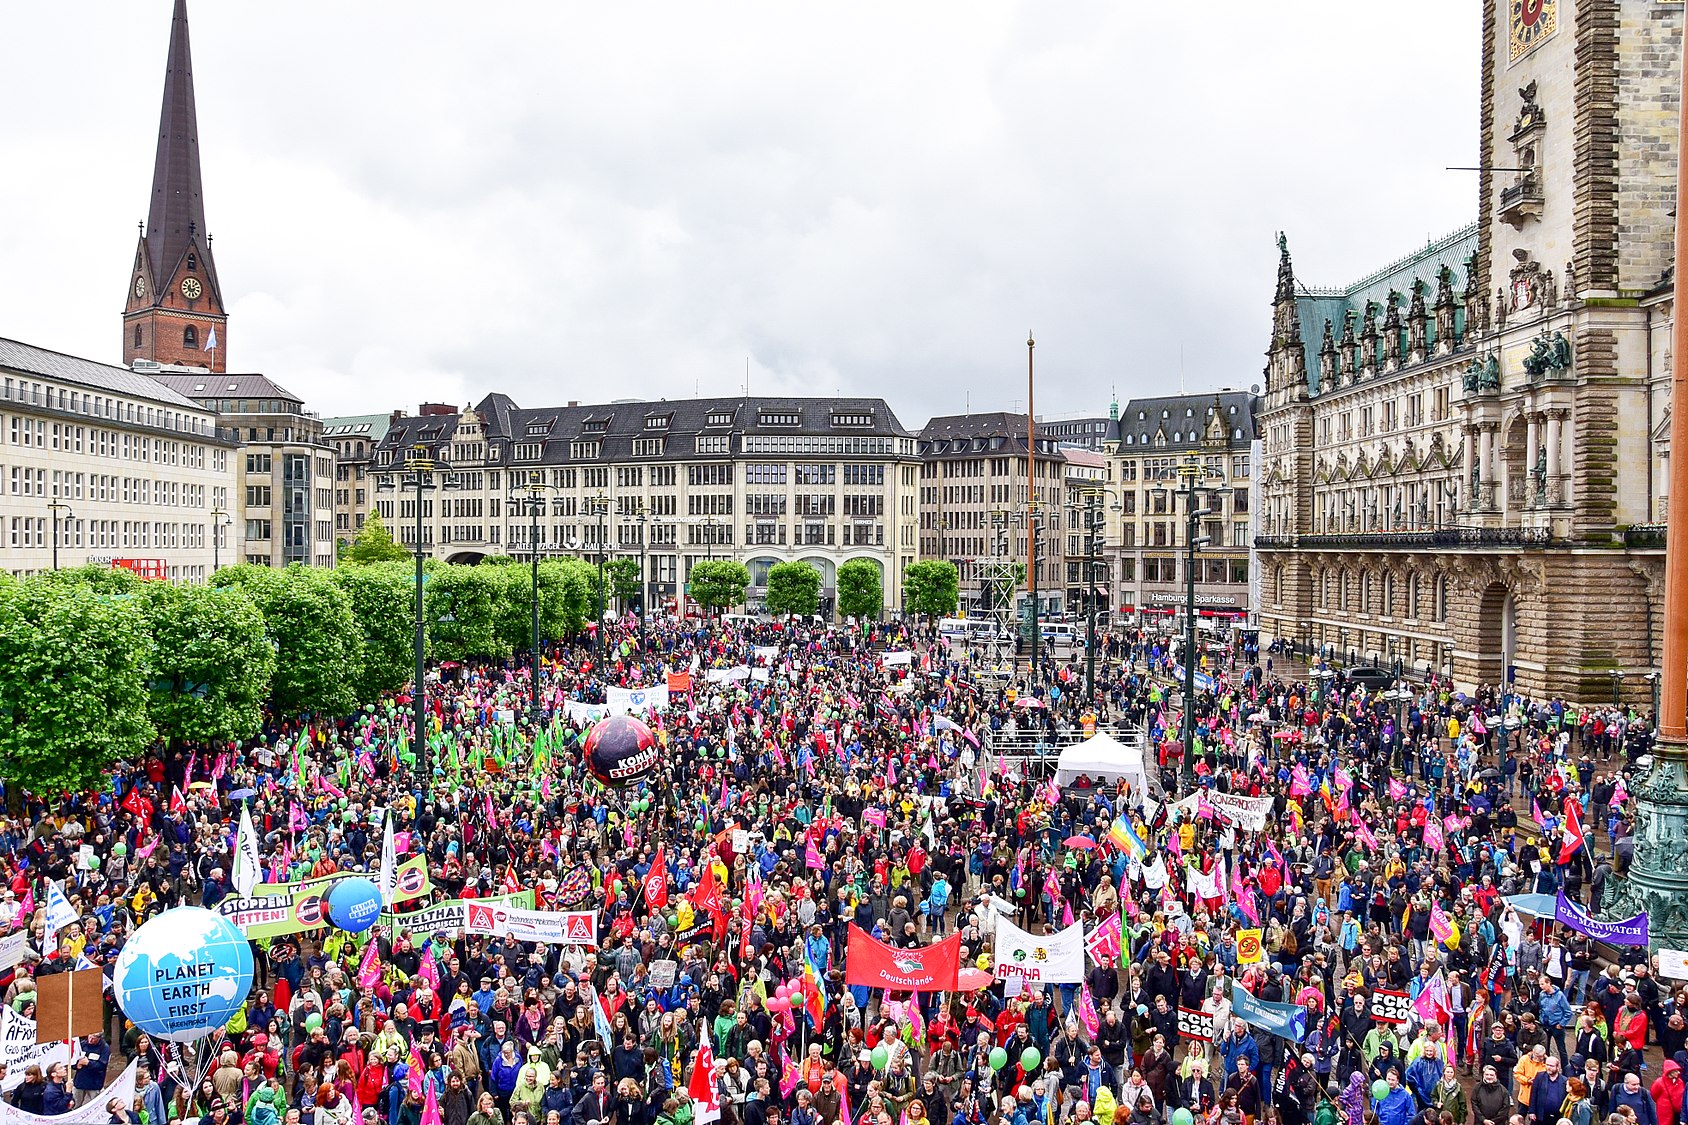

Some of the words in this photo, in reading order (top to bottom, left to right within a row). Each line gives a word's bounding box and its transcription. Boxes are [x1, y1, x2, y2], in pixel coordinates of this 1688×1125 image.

[1151, 593, 1189, 604] Hamburge
[1194, 594, 1235, 604] Sparkasse
[223, 895, 292, 914] STOPPEN!
[412, 918, 459, 933] KOLOGISCH
[155, 962, 216, 982] PLANET
[161, 982, 211, 1001] EARTH
[1371, 991, 1411, 1009] FCK
[168, 1002, 207, 1018] FIRST
[1370, 1004, 1408, 1020] G20
[1177, 1010, 1213, 1028] FCK
[1178, 1021, 1213, 1038] G20
